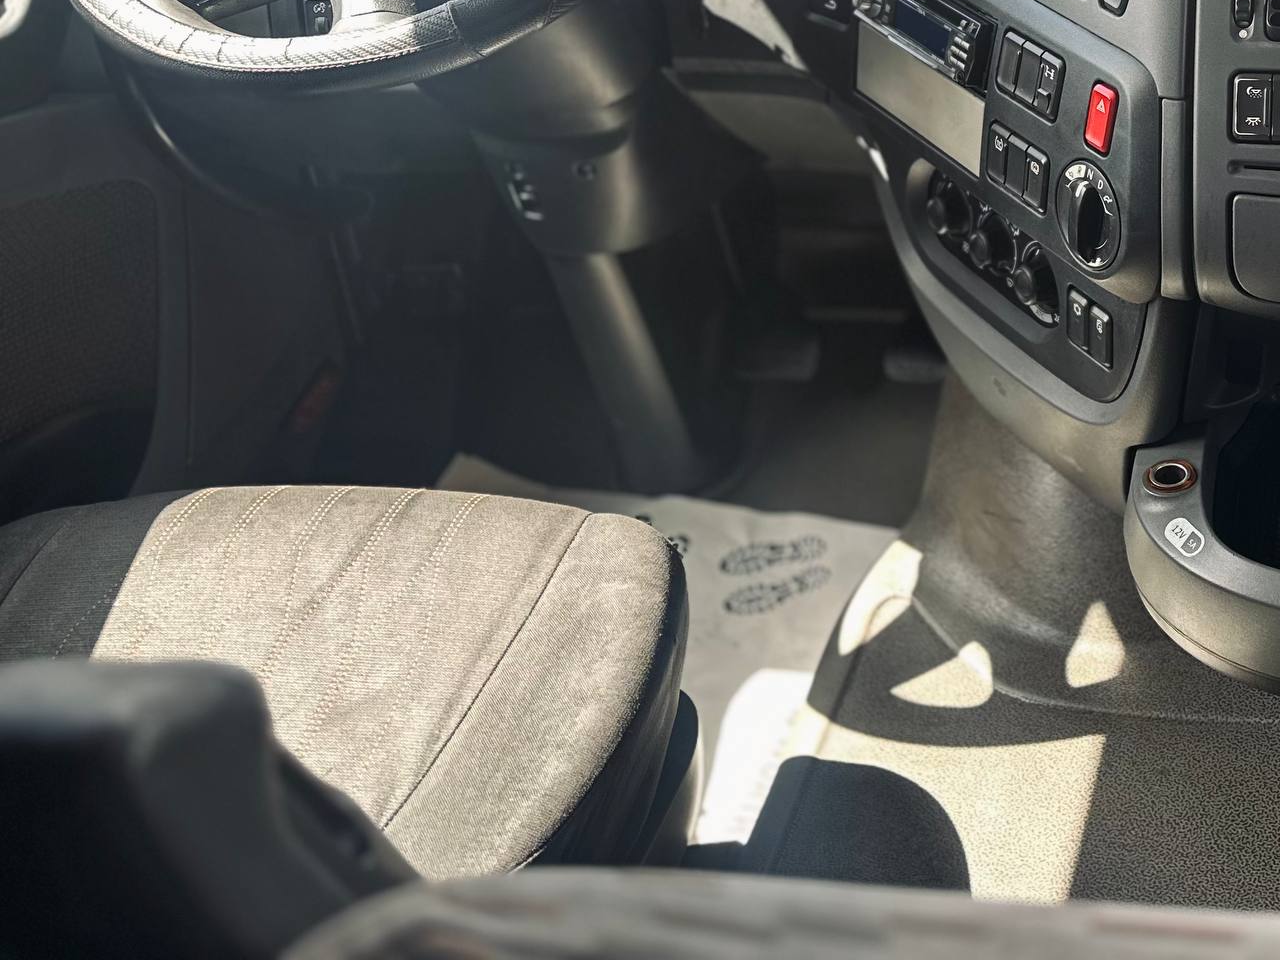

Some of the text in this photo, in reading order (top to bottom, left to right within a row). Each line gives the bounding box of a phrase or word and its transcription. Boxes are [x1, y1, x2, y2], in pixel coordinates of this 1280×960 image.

[1087, 168, 1094, 180] N
[1098, 180, 1104, 190] D
[1172, 524, 1187, 539] 12V
